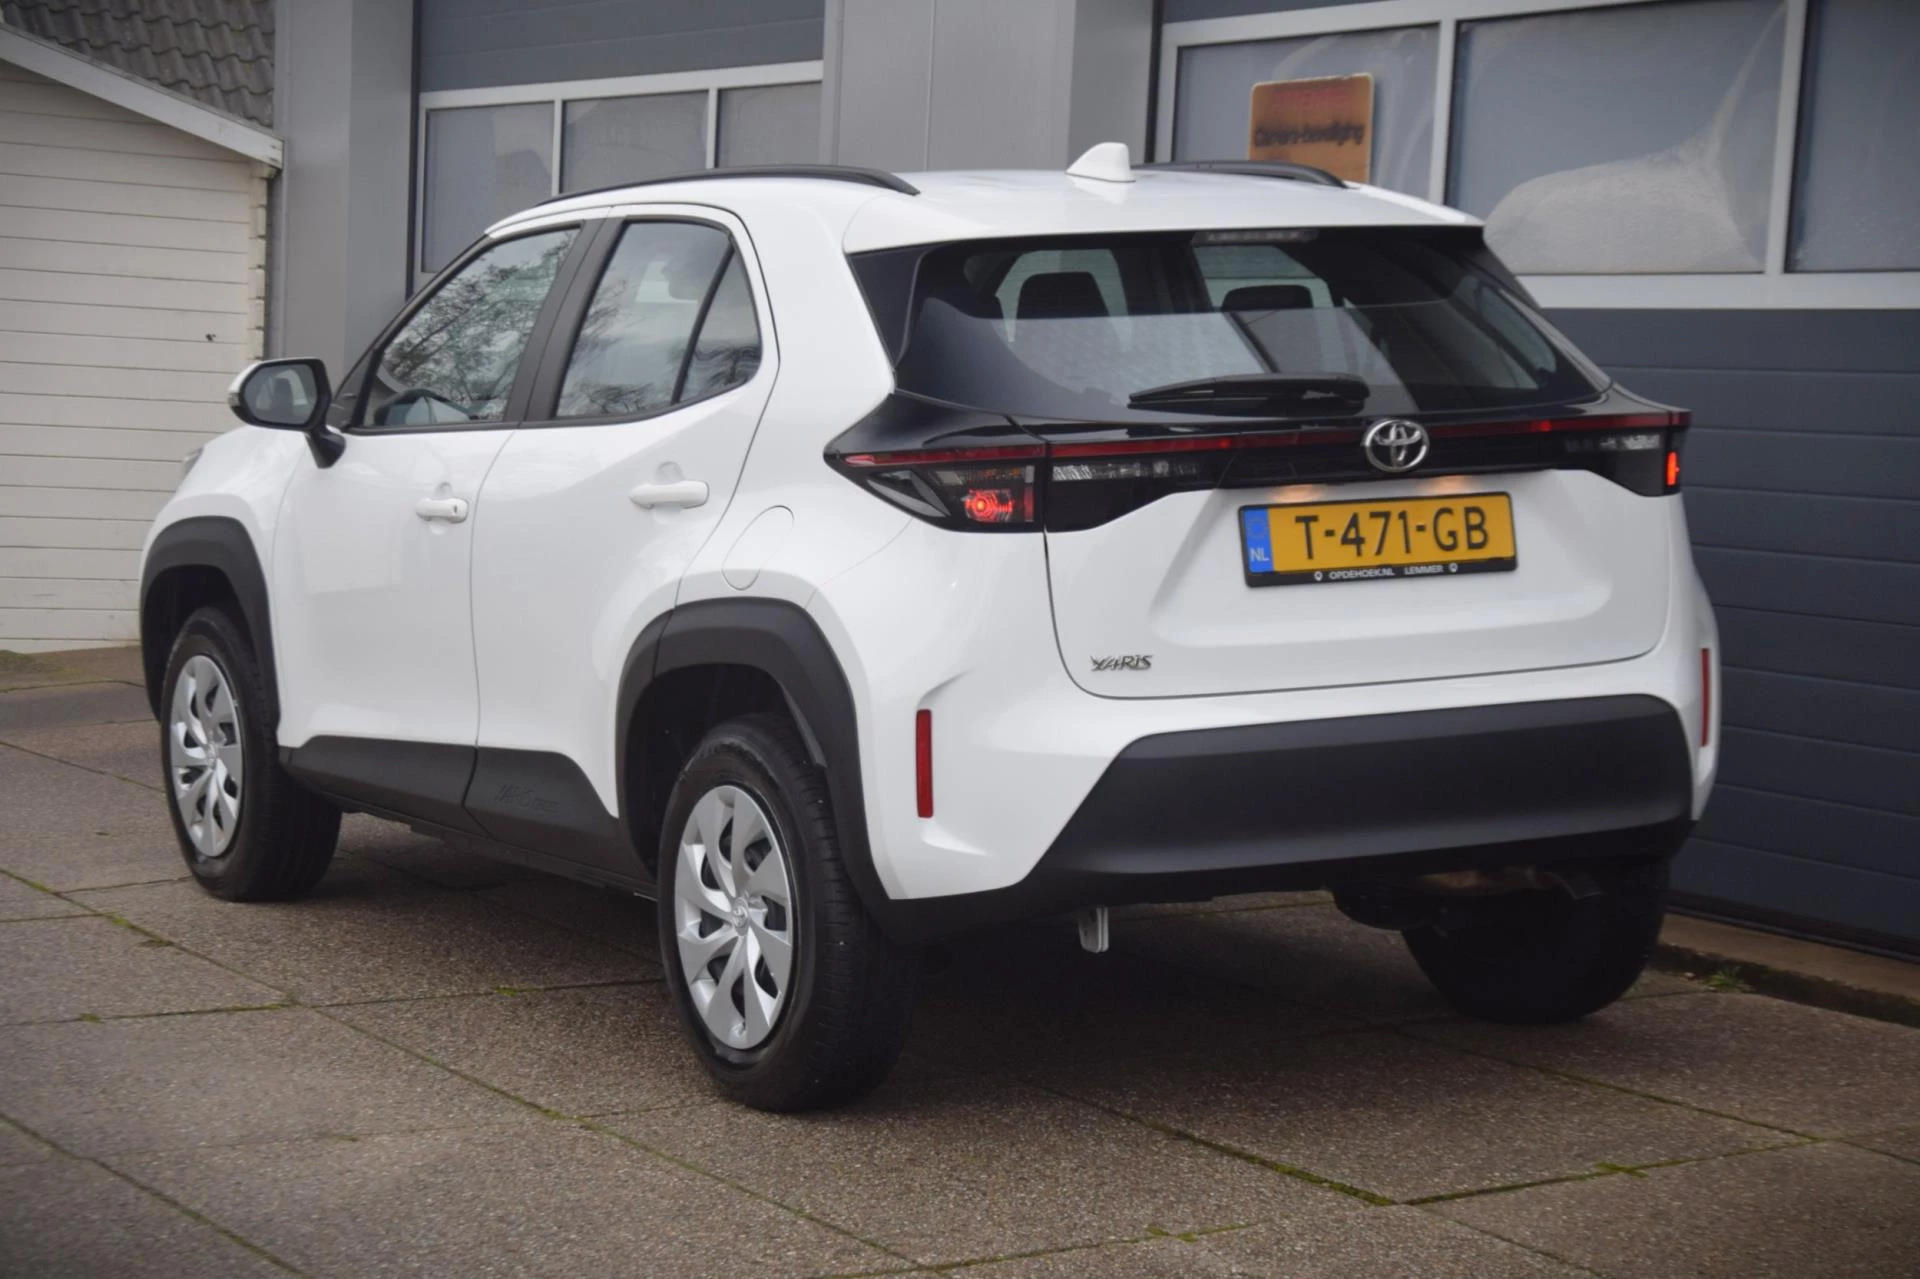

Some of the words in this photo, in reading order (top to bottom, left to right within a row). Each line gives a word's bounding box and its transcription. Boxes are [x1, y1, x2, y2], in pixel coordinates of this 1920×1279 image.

[1295, 506, 1490, 560] T-471-GB
[1250, 548, 1269, 562] NL
[1404, 563, 1443, 575] LEMMER
[1090, 654, 1153, 671] YARIS
